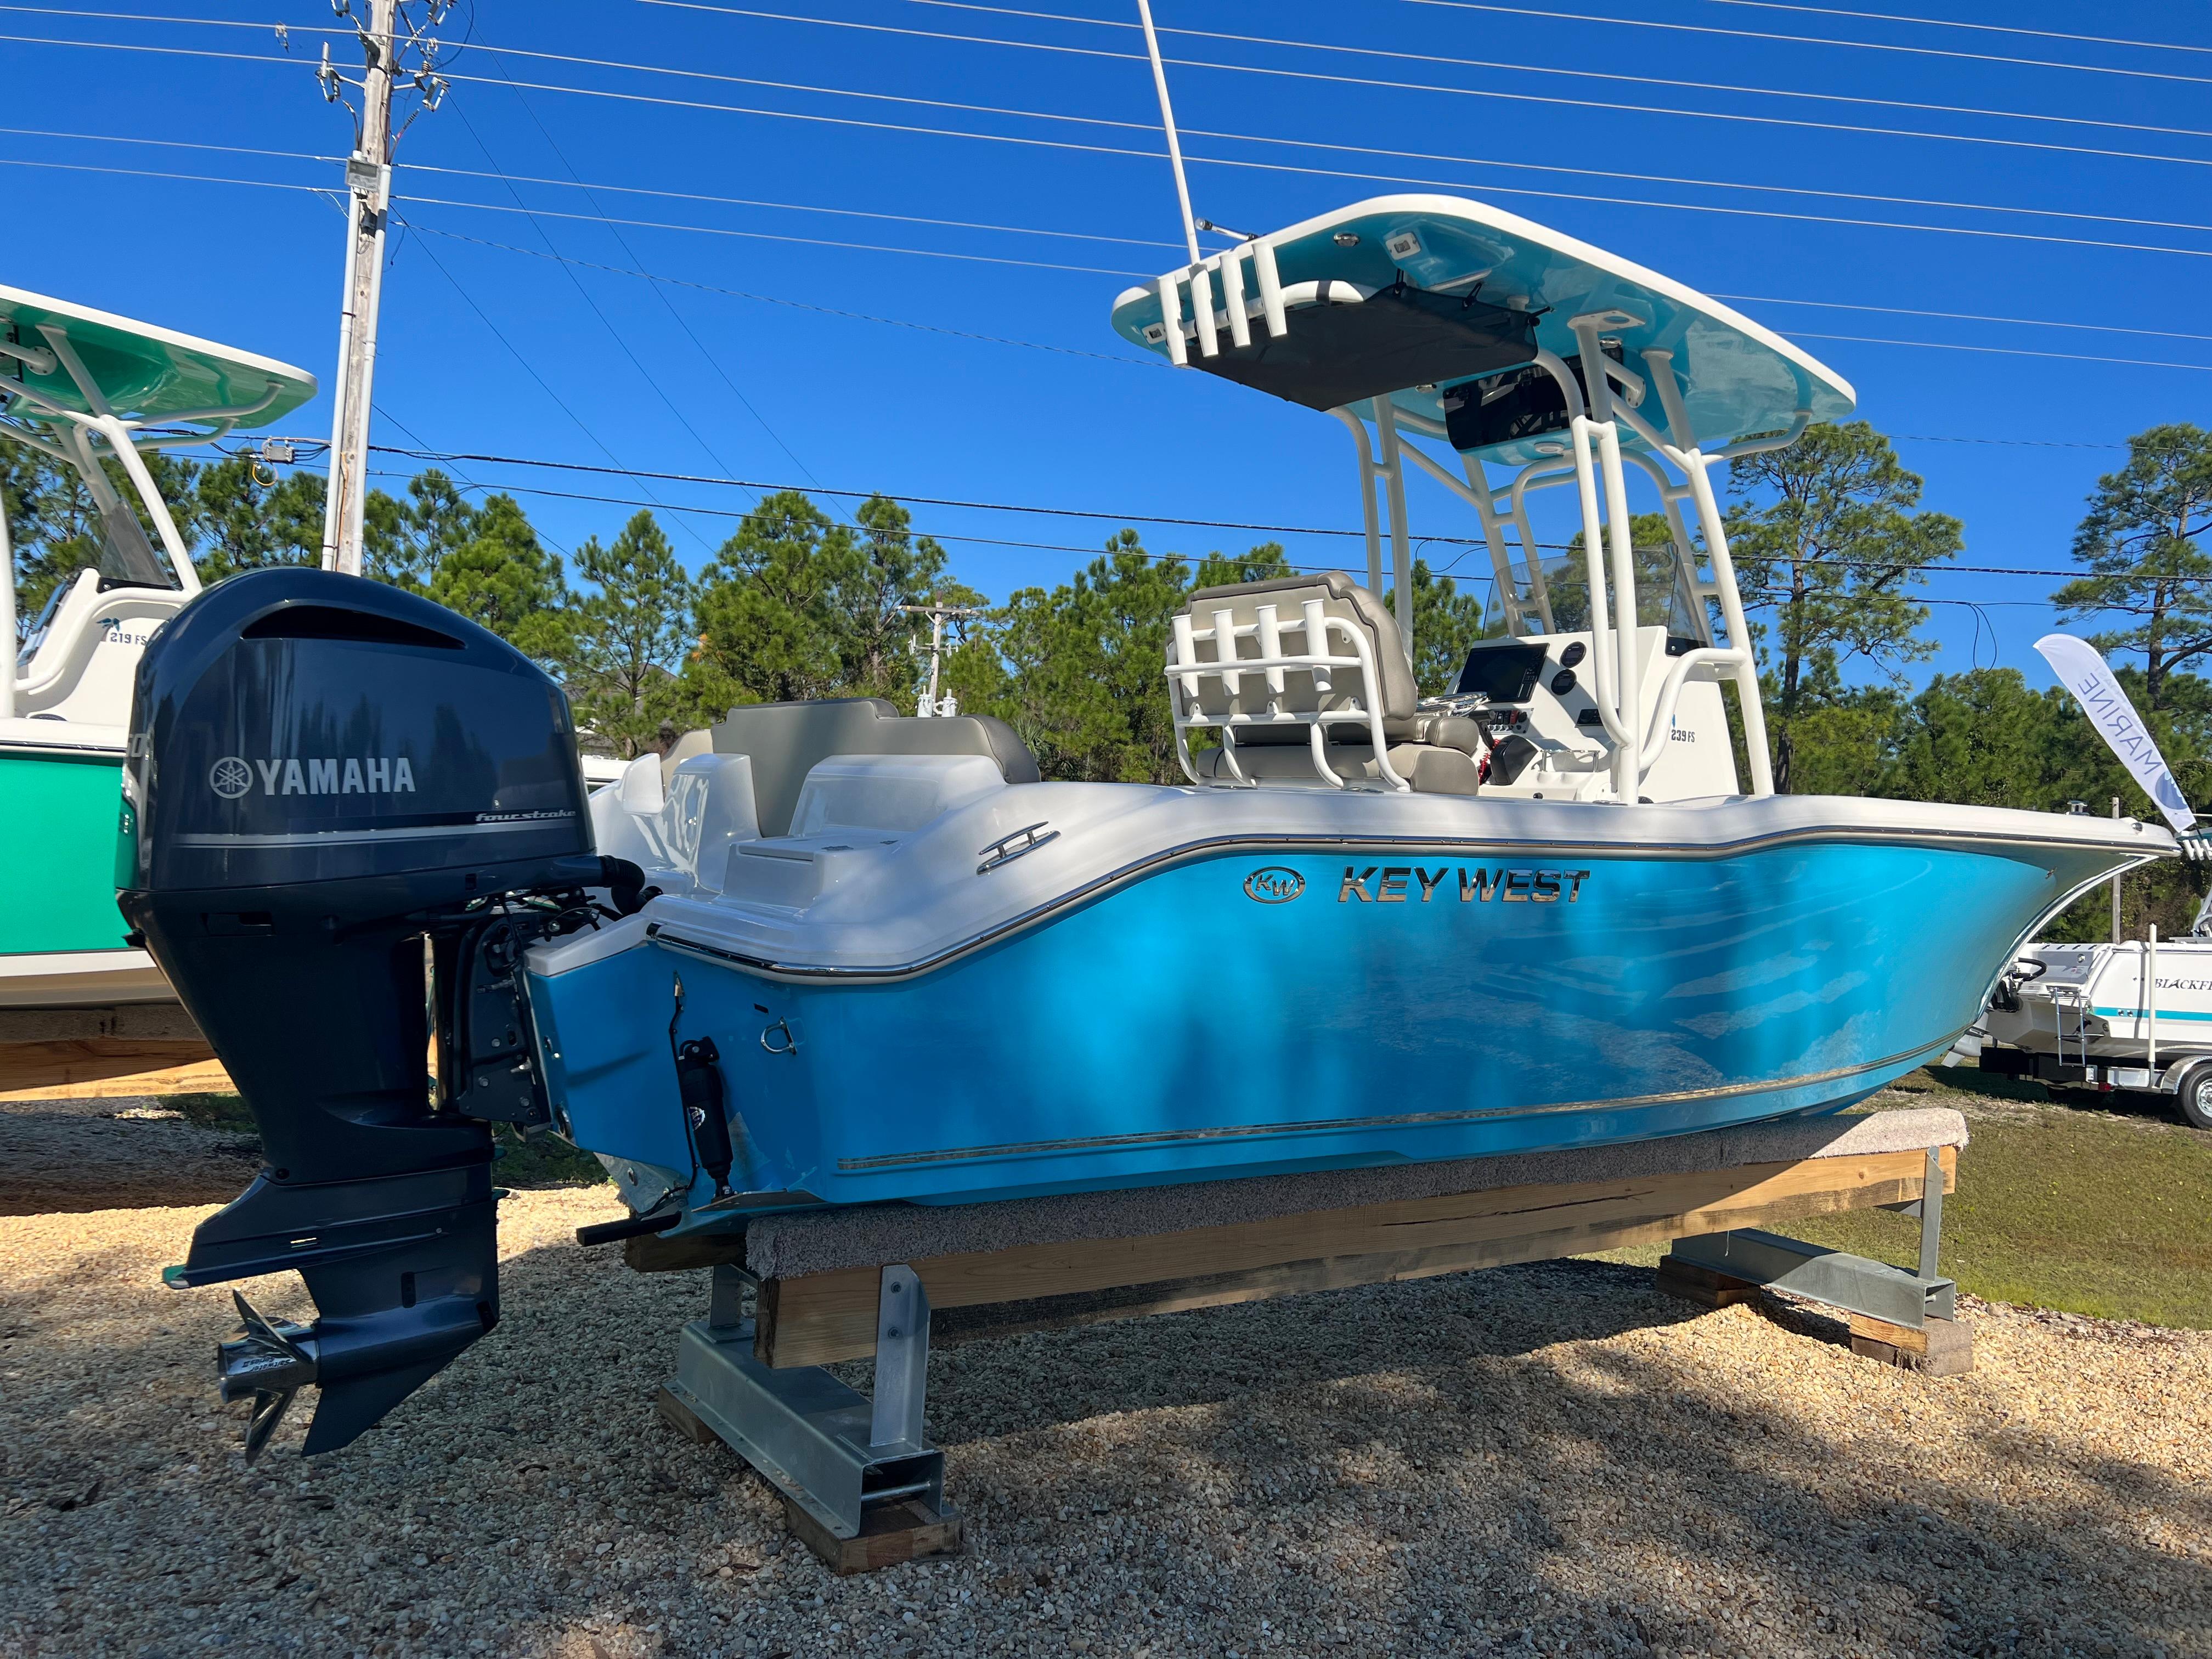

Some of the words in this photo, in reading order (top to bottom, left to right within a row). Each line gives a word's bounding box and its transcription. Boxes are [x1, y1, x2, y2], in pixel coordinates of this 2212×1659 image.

[110, 632, 132, 644] 219
[135, 635, 148, 646] FS
[1671, 729, 1686, 742] 239
[1688, 731, 1695, 743] FS
[255, 757, 416, 795] YAMAHA
[1338, 866, 1449, 902] KEY
[1457, 867, 1591, 902] WEST
